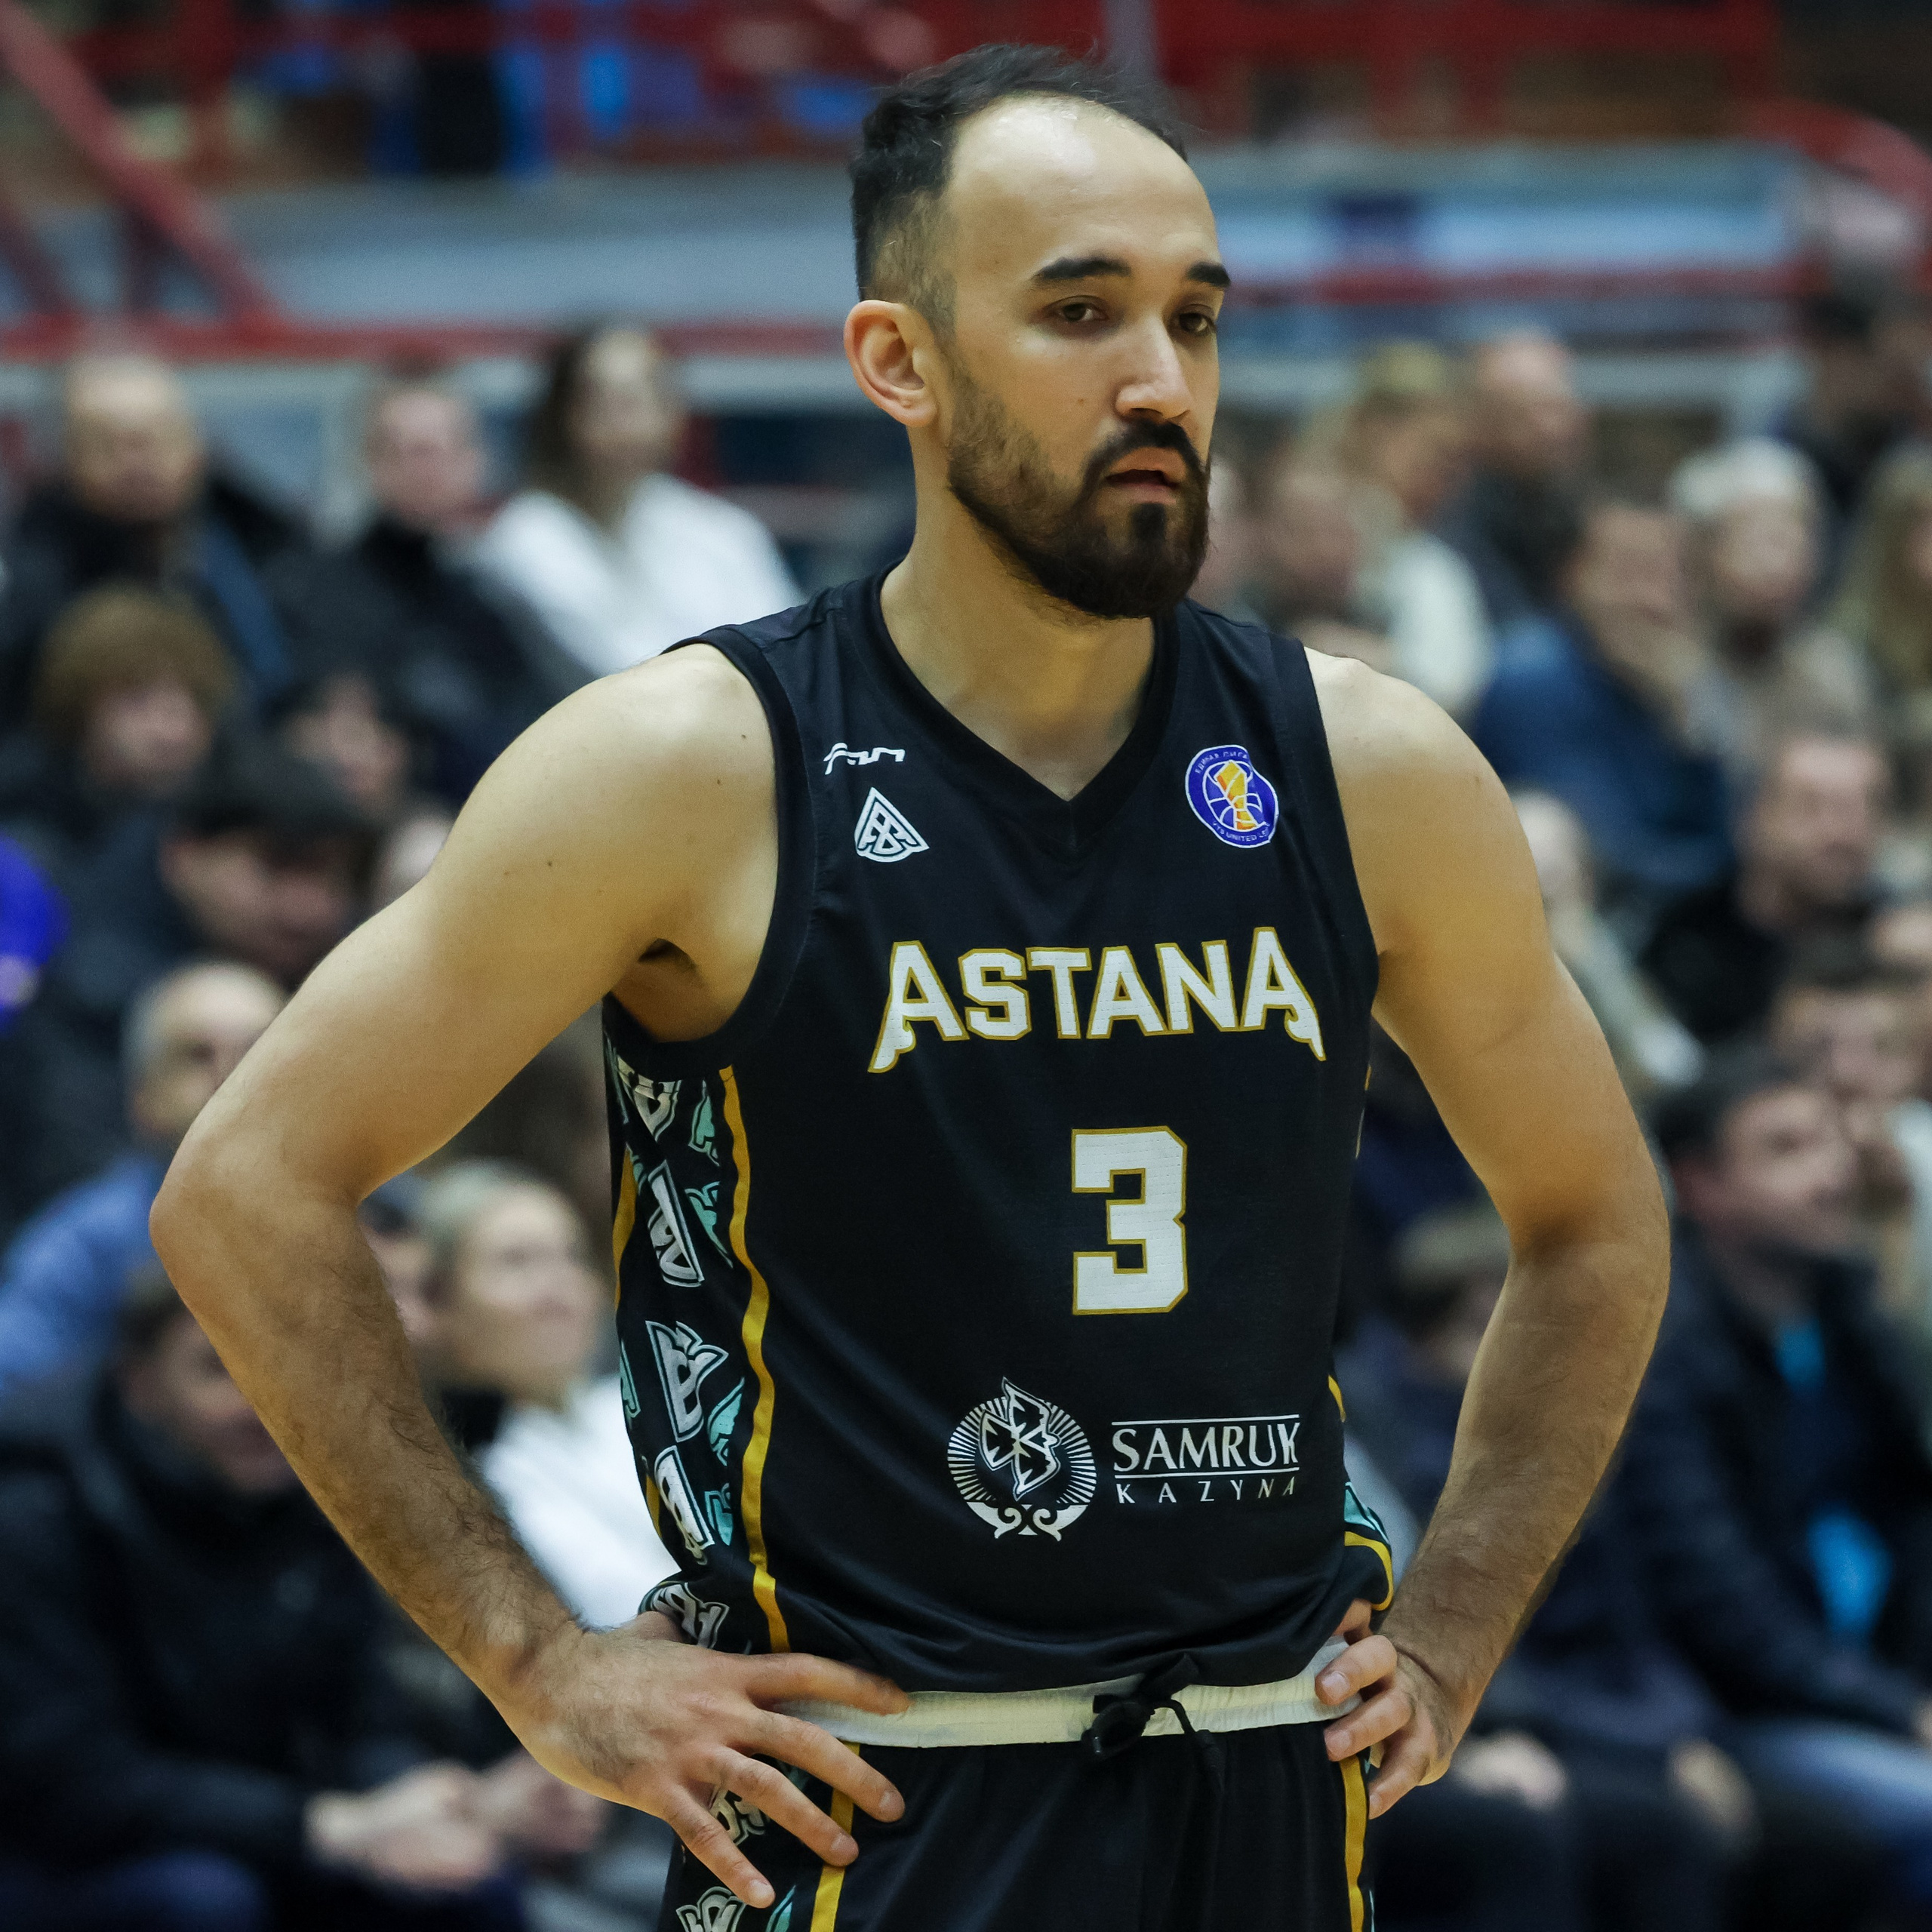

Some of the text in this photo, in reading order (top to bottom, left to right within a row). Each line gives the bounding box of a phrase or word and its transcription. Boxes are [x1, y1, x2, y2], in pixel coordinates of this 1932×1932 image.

[1226, 832, 1257, 842] UNITED
[866, 926, 1327, 1074] ASTANA
[1071, 1125, 1189, 1316] 3
[1112, 1422, 1301, 1472] SAMRUK
[1117, 1475, 1297, 1505] KAZYNA
